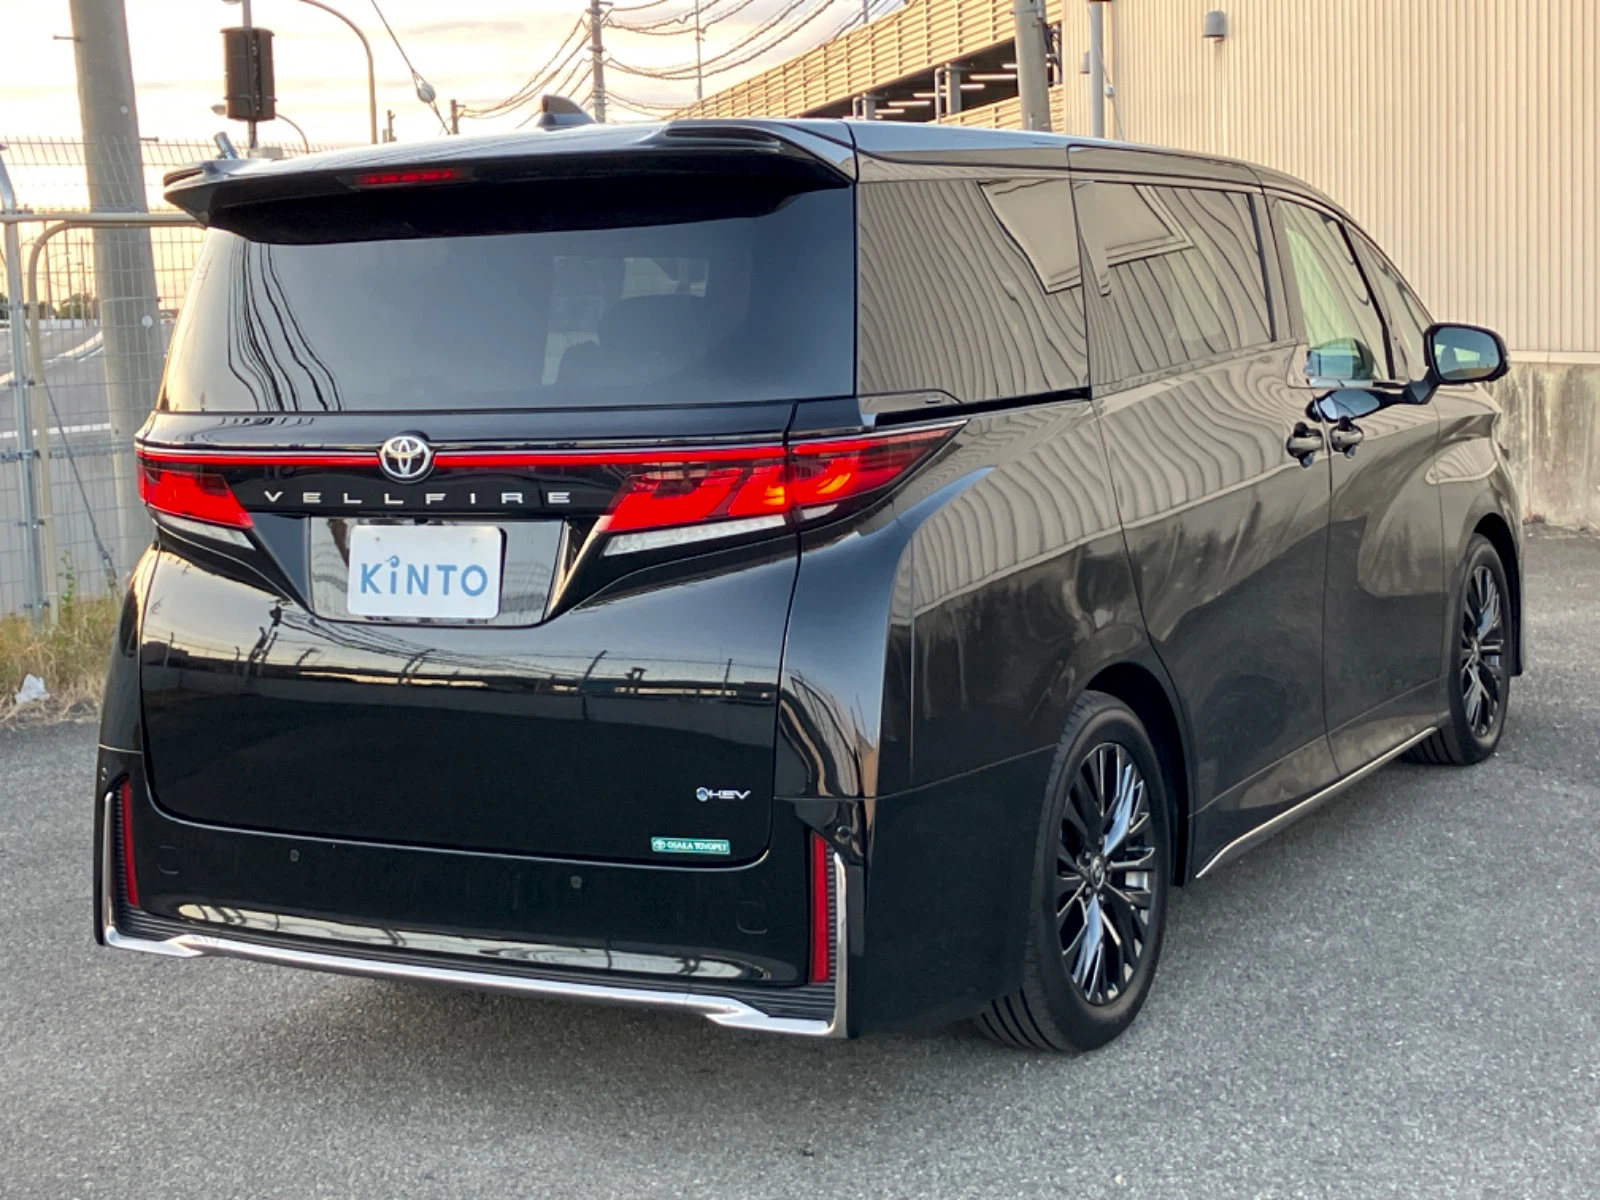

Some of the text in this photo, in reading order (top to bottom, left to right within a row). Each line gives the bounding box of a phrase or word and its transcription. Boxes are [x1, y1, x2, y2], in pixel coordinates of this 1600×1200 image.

[264, 491, 571, 505] VELLFIRE
[707, 789, 751, 799] HEV
[667, 841, 693, 850] OSAKA
